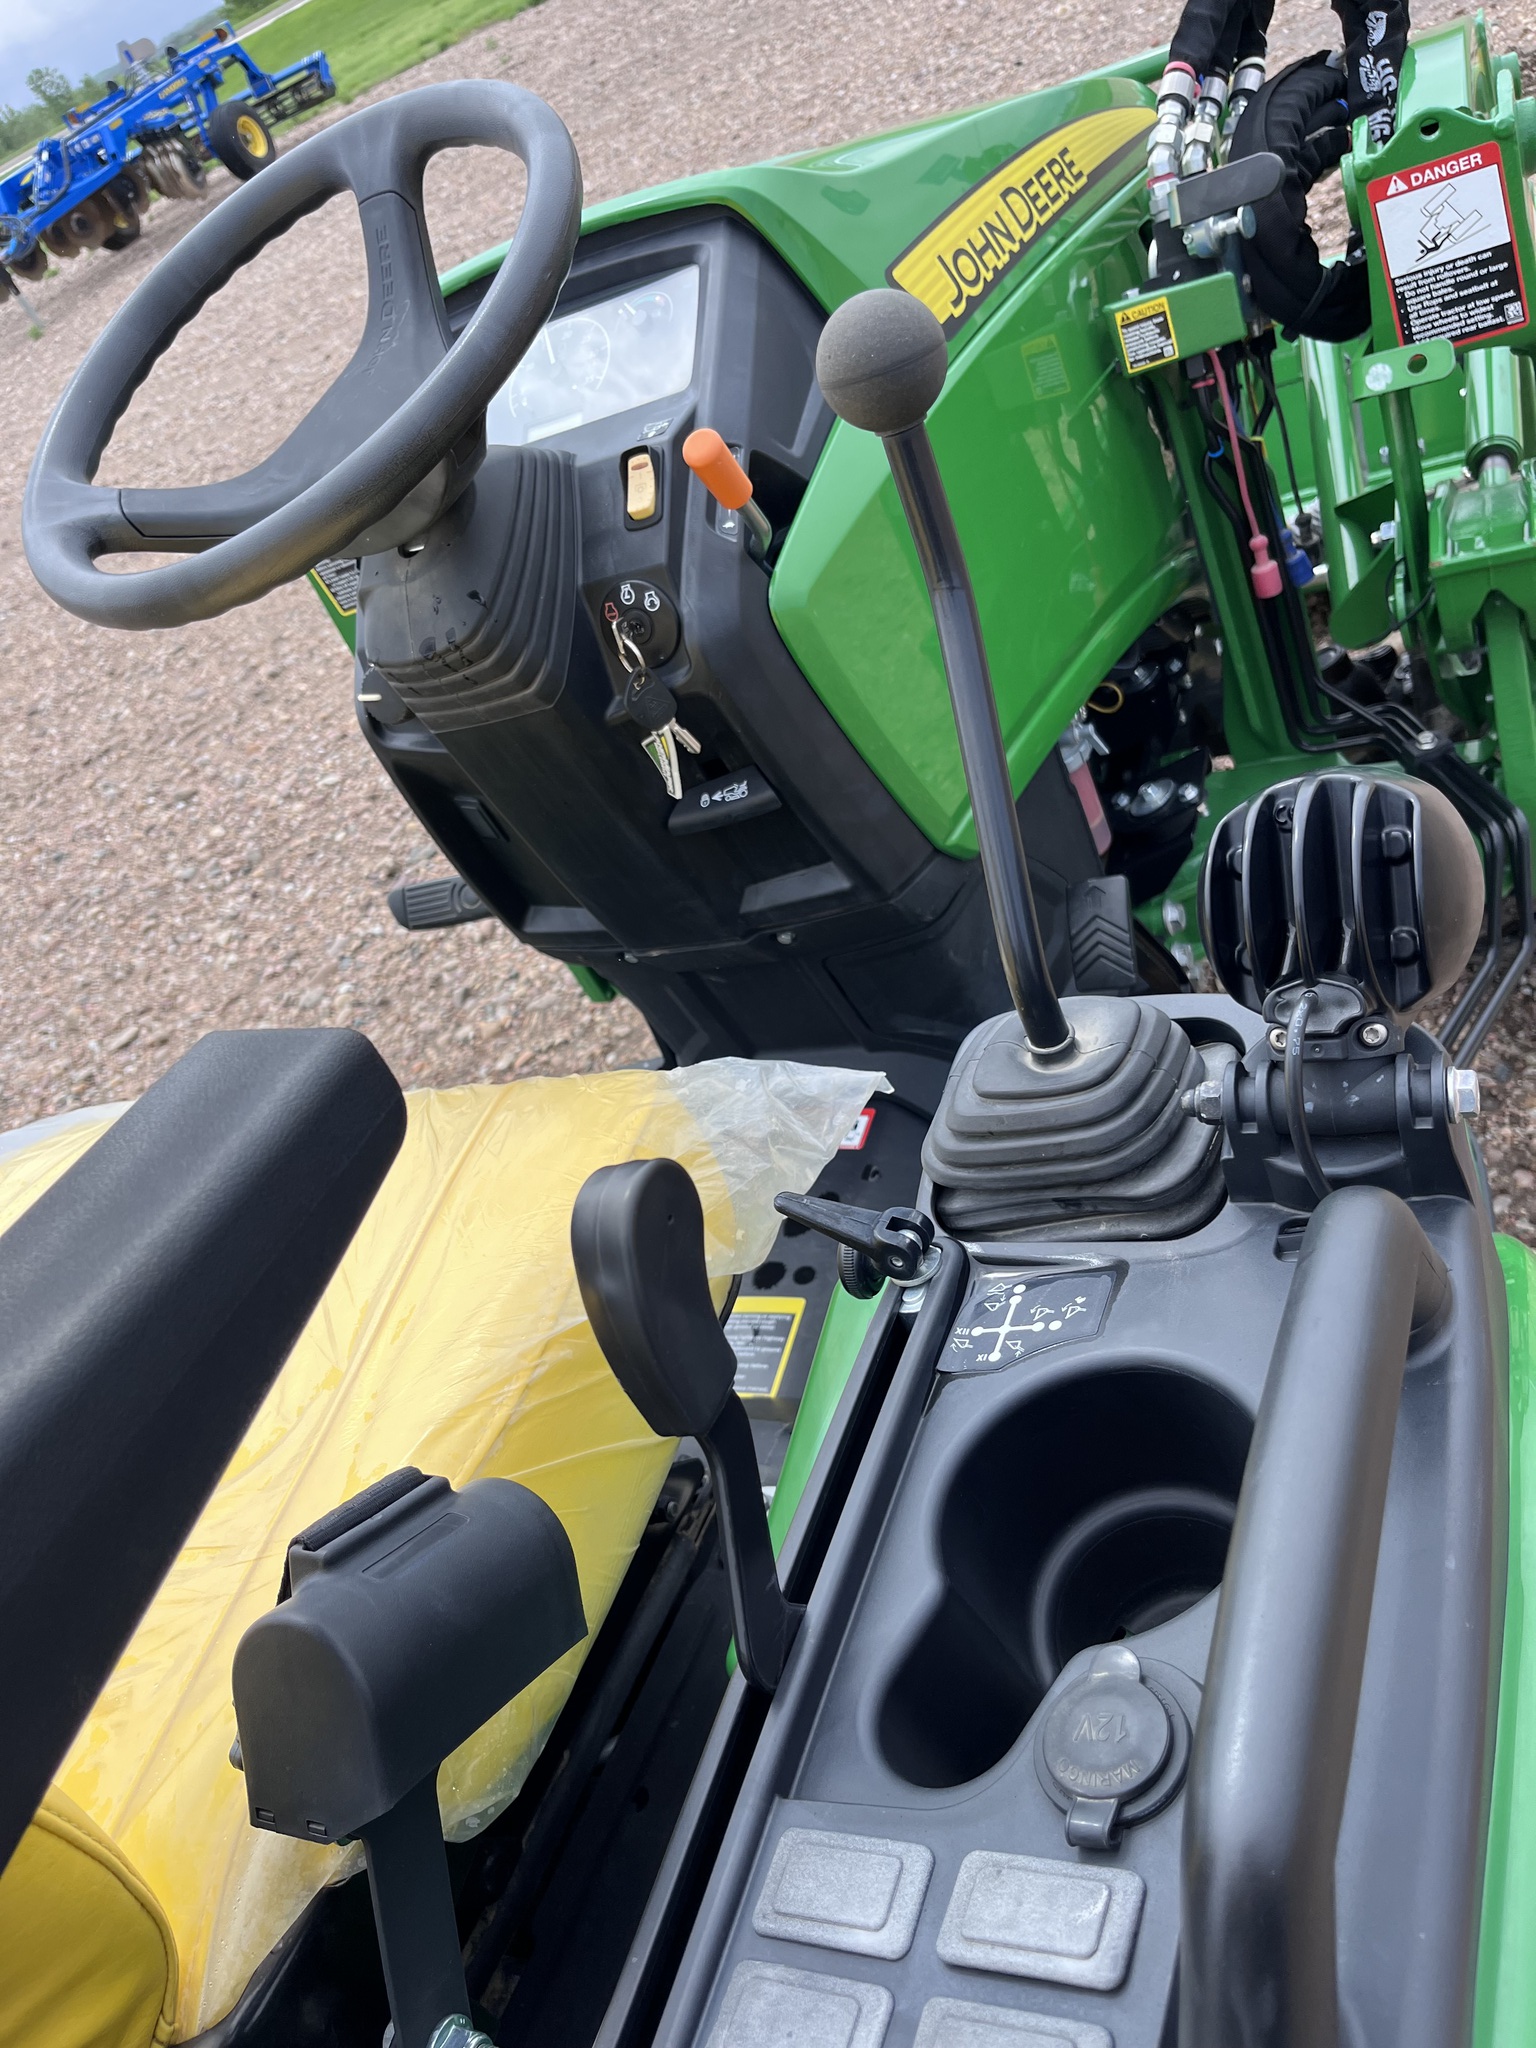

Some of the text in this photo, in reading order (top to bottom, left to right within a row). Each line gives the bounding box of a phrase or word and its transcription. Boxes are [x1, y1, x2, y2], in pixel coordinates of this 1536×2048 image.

[1410, 152, 1483, 187] DANGER
[937, 147, 1085, 309] JOHN DEERE
[375, 225, 394, 321] DEERE
[1394, 251, 1492, 286] Serious injury or death can
[1396, 266, 1471, 293] result from rollovers.
[1404, 262, 1508, 298] Do not handle round or large
[1131, 301, 1165, 319] CAUTION
[1406, 286, 1455, 305] square bales.
[1407, 303, 1422, 312] Use
[1443, 291, 1458, 301] and
[1459, 282, 1489, 297] seatbelt
[1490, 279, 1498, 287] at
[1410, 289, 1516, 326] Operate tractor at low speed.
[1409, 311, 1418, 319] all
[1411, 323, 1432, 334] Move
[1432, 315, 1459, 327] wheels
[1469, 304, 1494, 316] widest
[1413, 319, 1466, 340] recommended
[1461, 324, 1477, 333] rear
[1073, 1712, 1128, 1744] 12V
